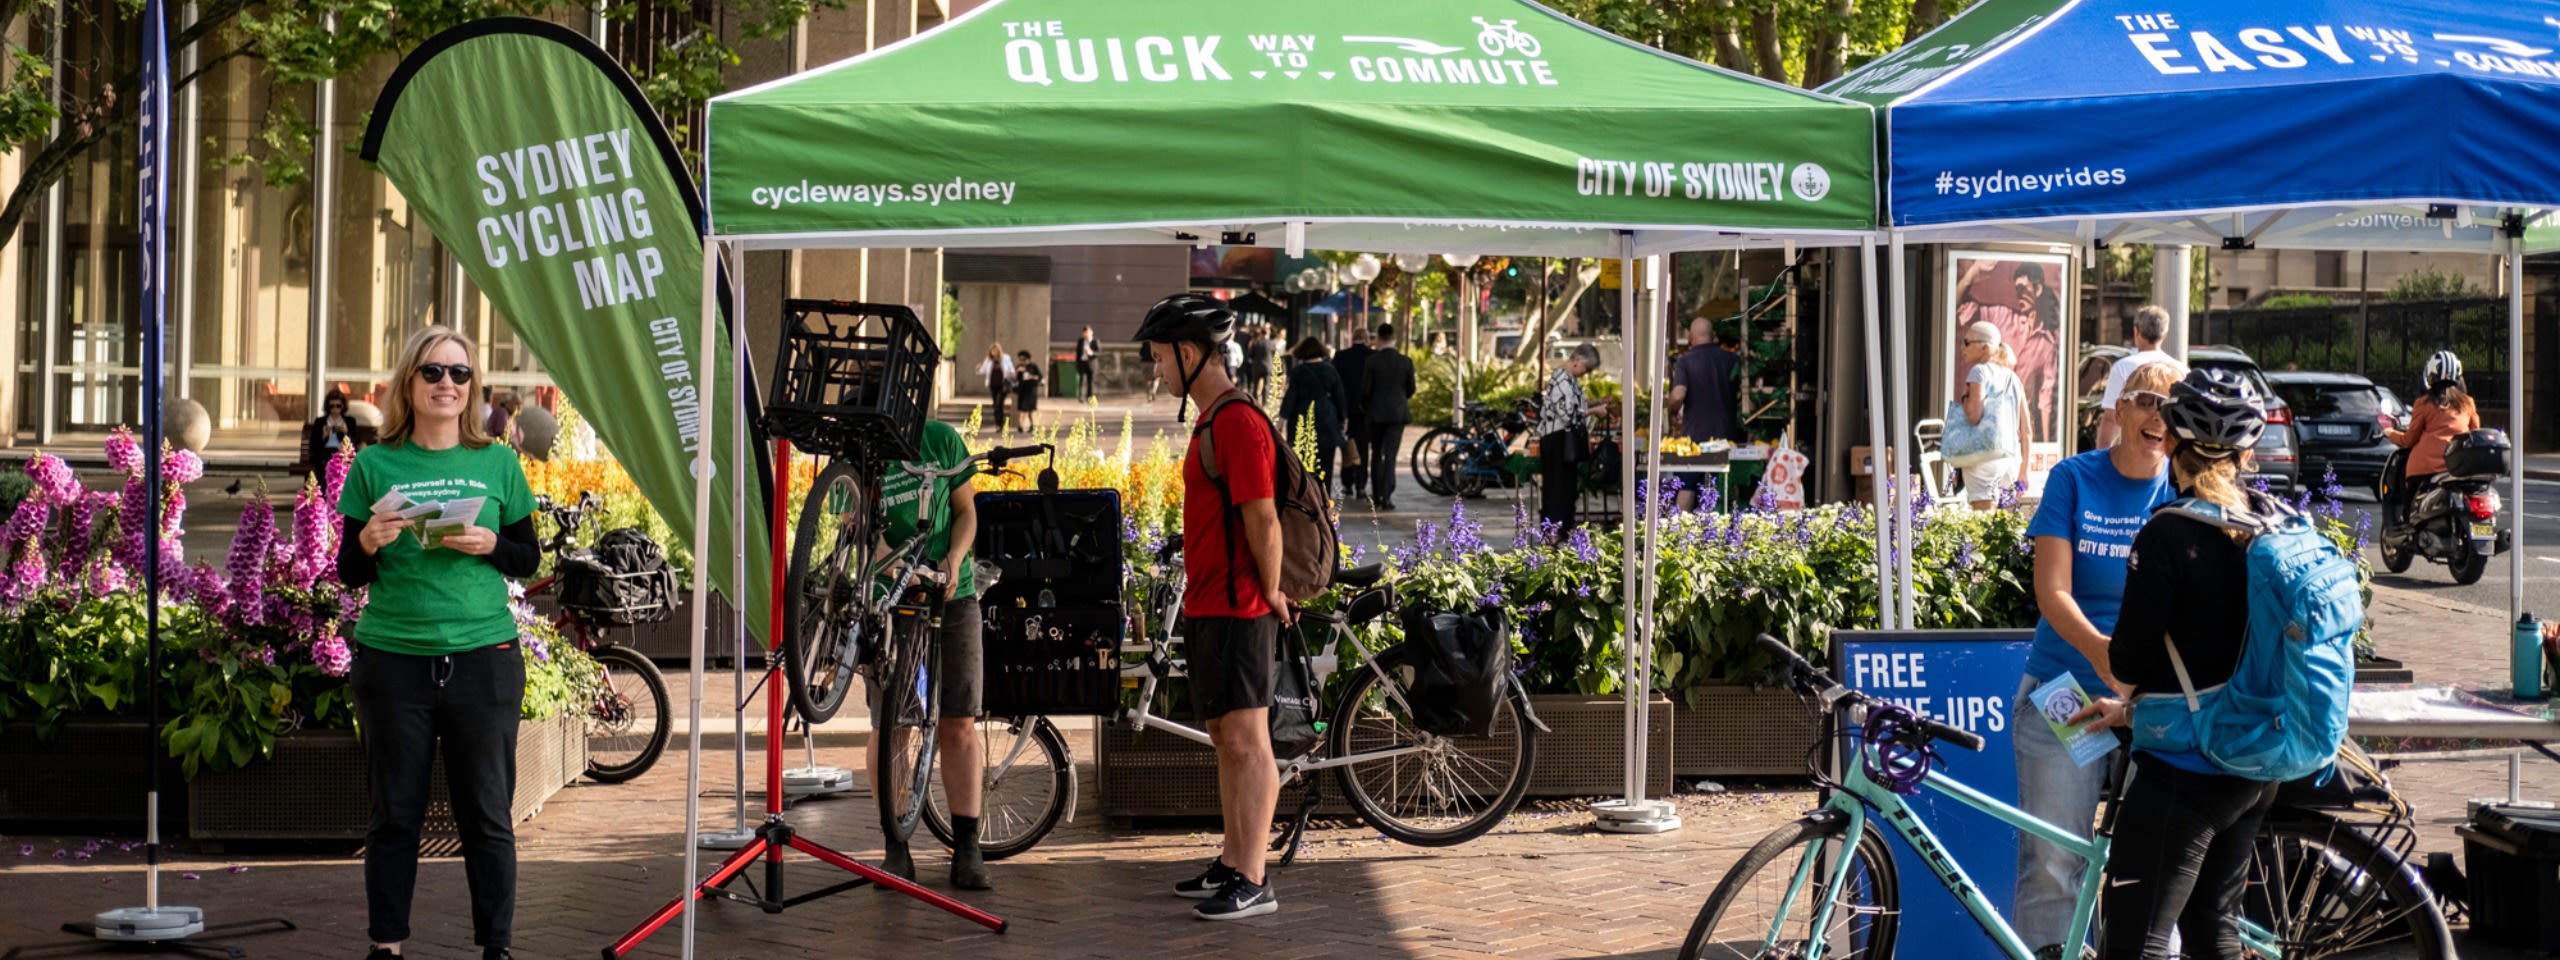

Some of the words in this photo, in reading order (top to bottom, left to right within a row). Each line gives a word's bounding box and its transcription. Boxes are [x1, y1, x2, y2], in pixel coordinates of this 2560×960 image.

[1002, 21, 1064, 37] THE
[2115, 13, 2180, 31] THE
[2344, 25, 2414, 45] WAY
[1248, 34, 1316, 52] WAY
[2128, 25, 2355, 75] EASY
[2372, 42, 2419, 57] TO
[1004, 35, 1233, 86] QUICK
[1265, 51, 1308, 68] TO
[1349, 56, 1558, 86] COMMUTE
[476, 128, 633, 207] SYDNEY
[1577, 157, 1637, 197] CITY
[1644, 161, 1677, 198] OF
[1682, 162, 1784, 201] SYDNEY
[1935, 166, 2127, 199] #sydneyrides
[751, 176, 1016, 210] cycleways.sydney
[477, 187, 654, 269] CYCLING
[573, 246, 664, 311] MAP
[650, 317, 685, 357] CITY
[661, 359, 692, 382] OF
[412, 479, 446, 488] yourself
[2082, 523, 2140, 538] cycleways.syd
[2084, 510, 2102, 522] Give
[2104, 516, 2141, 525] yourself
[2078, 539, 2098, 555] CITY
[2098, 543, 2109, 556] OF
[2109, 544, 2131, 558] SYDN
[1854, 653, 1927, 688] FREE
[1892, 696, 2005, 732] E-UPS
[1893, 800, 1976, 899] TREK
